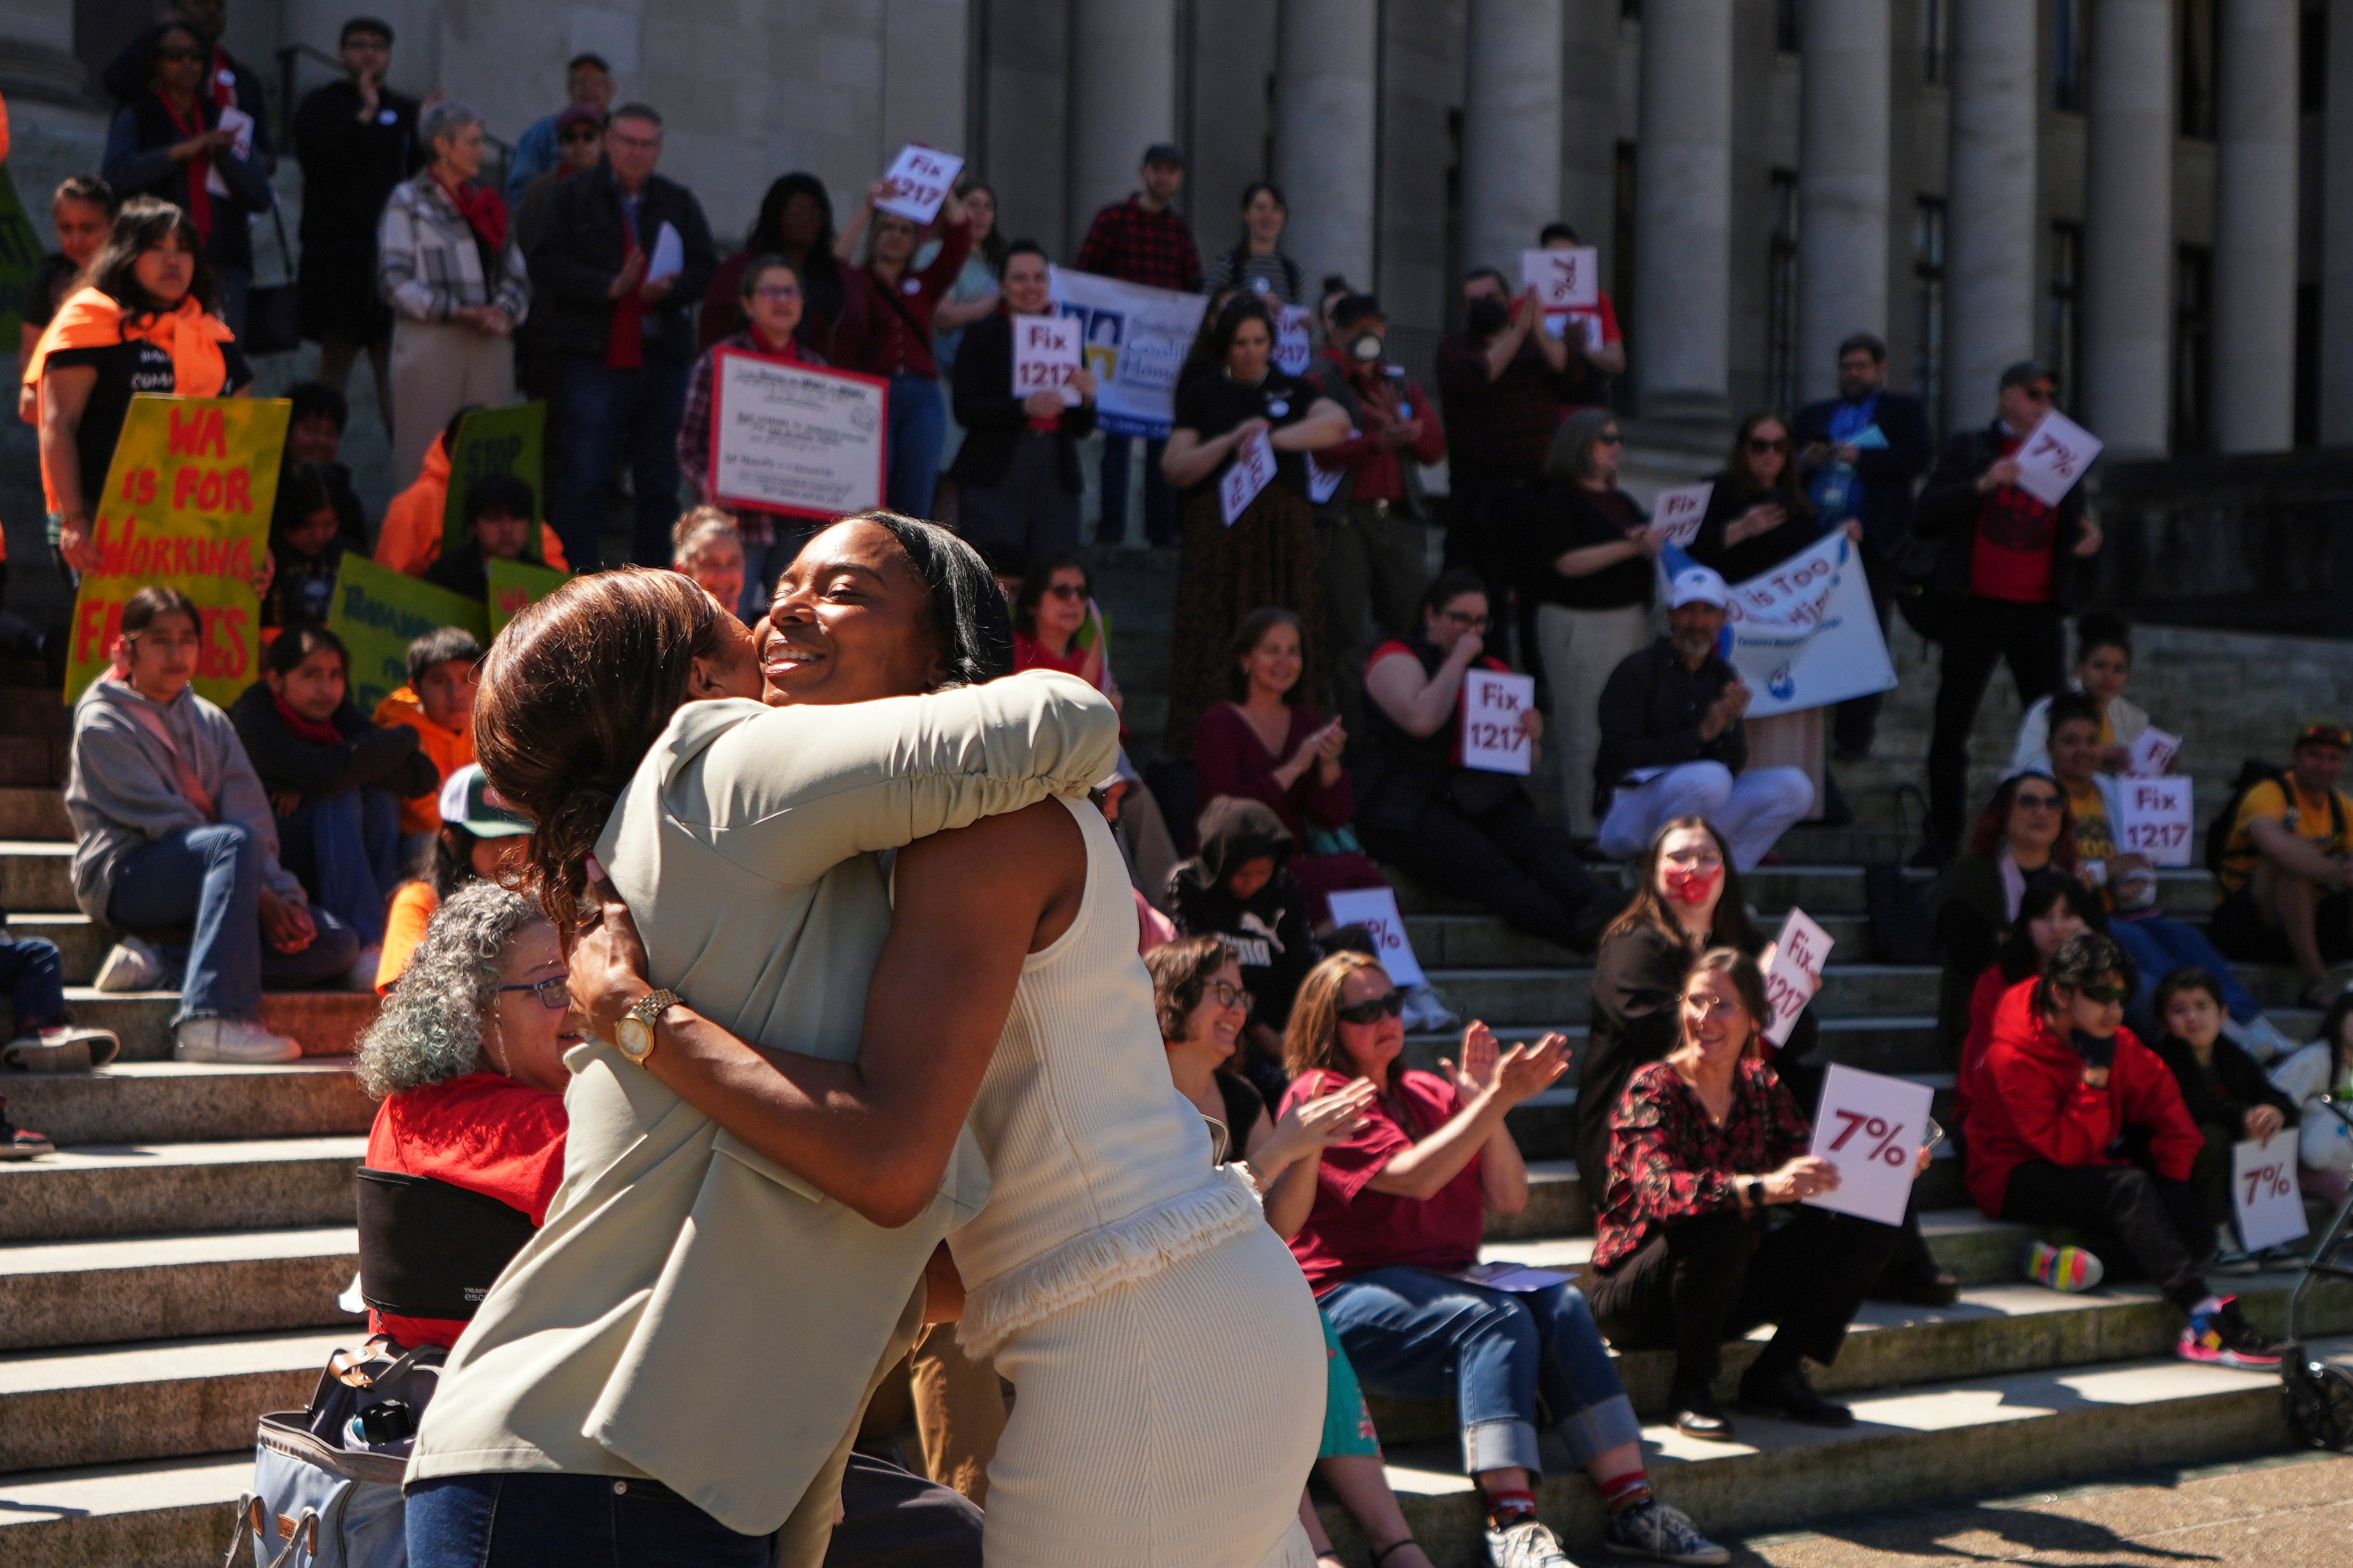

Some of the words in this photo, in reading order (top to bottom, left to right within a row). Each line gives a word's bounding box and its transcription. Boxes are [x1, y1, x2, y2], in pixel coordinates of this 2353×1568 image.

[896, 178, 942, 206] 217
[1552, 256, 1577, 301] 7%
[1029, 325, 1066, 349] Fix
[1020, 362, 1076, 386] 1217
[169, 406, 228, 459] WA
[2031, 434, 2078, 478] 7%
[121, 469, 158, 506] IS
[174, 466, 253, 514] FOR
[1668, 495, 1698, 515] Fix
[1666, 517, 1701, 538] 217
[1483, 682, 1519, 710] Fix
[1472, 722, 1527, 752] 1217
[2137, 787, 2177, 811] Fix
[2128, 823, 2190, 848] 1217
[1788, 928, 1813, 973] Fix
[1828, 1107, 1907, 1168] 7%
[2244, 1162, 2290, 1206] 7%
